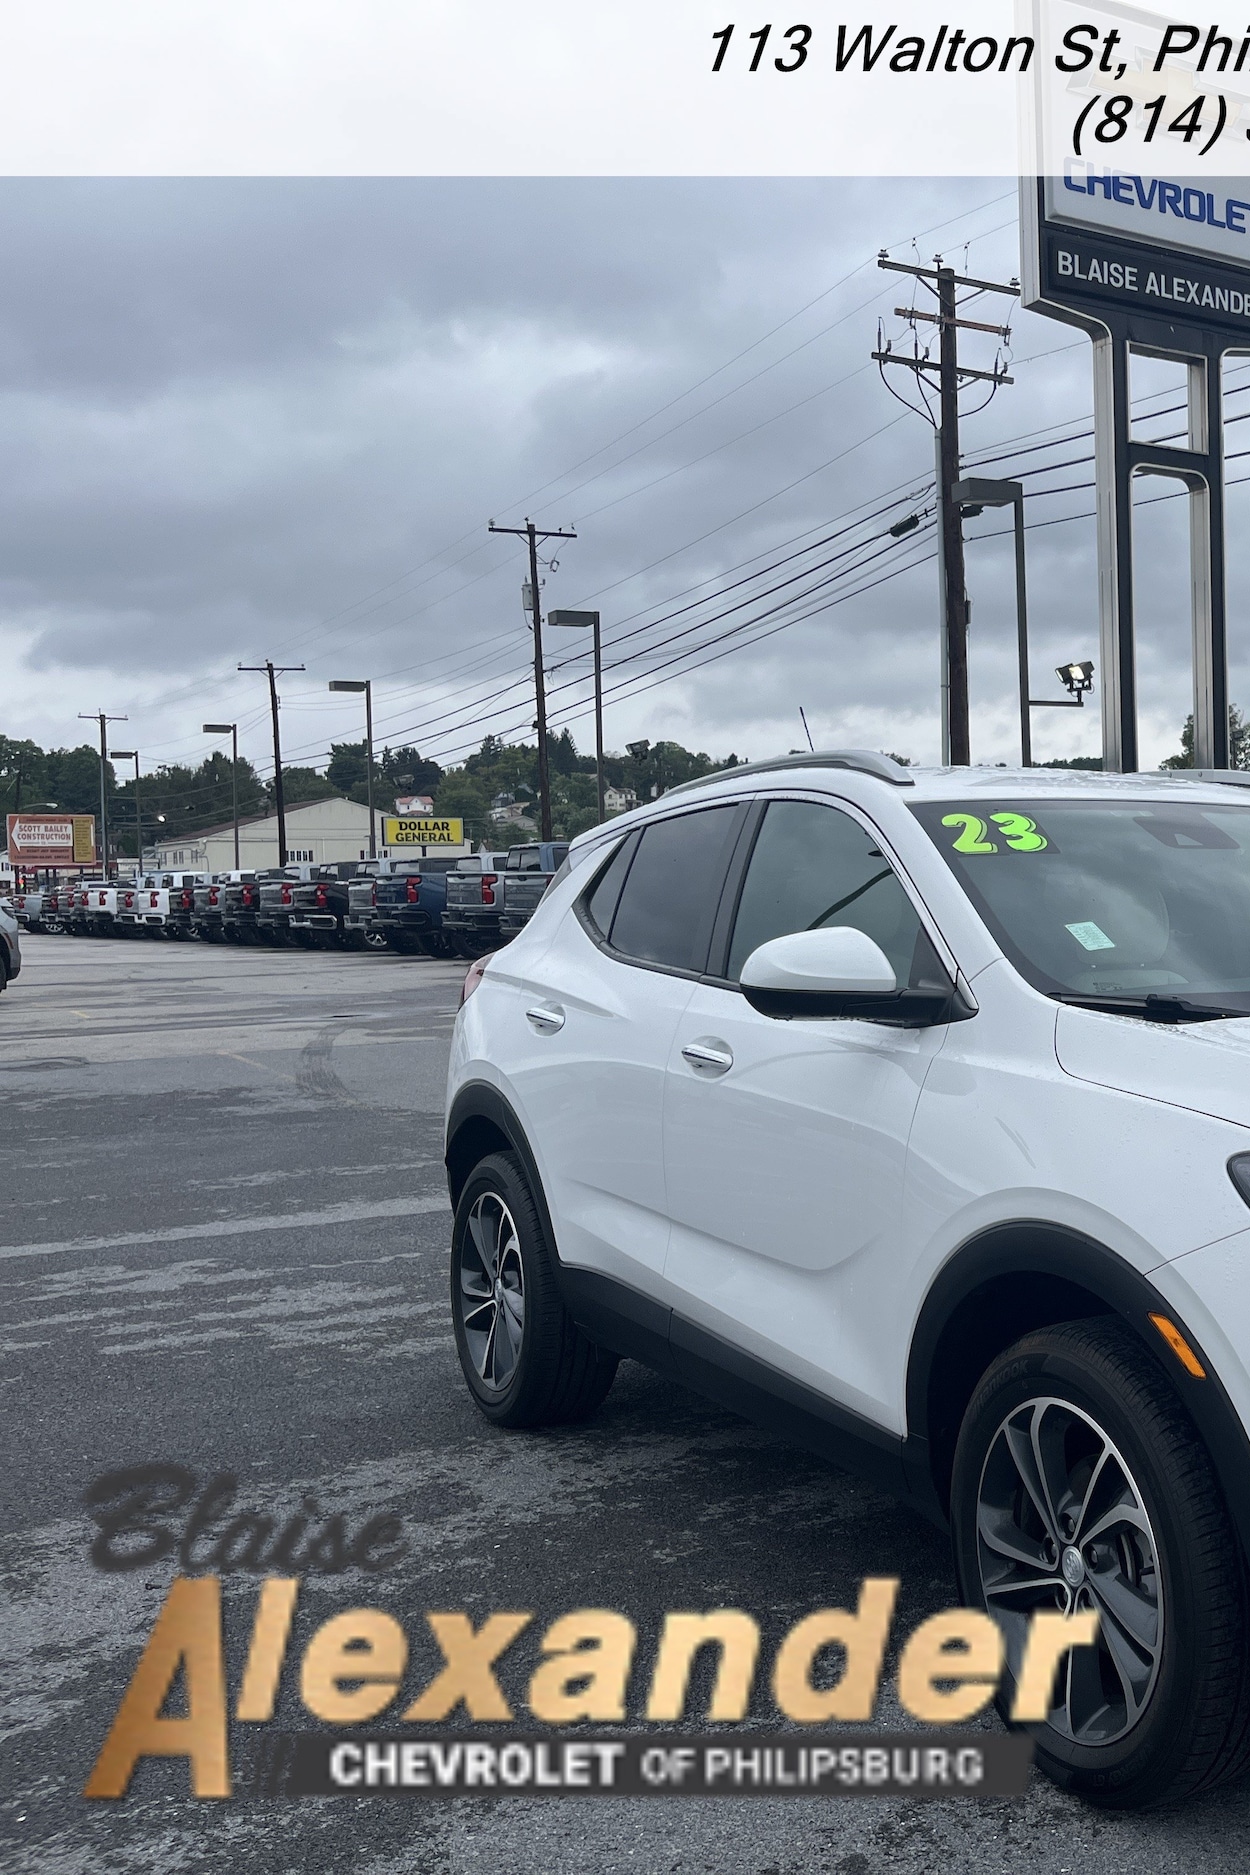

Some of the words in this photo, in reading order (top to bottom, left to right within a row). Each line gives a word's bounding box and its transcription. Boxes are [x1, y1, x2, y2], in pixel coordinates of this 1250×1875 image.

[1057, 250, 1139, 292] BLAISE
[18, 824, 41, 833] SCOTT
[44, 824, 69, 833] BAILEY
[398, 821, 450, 831] DOLLAR
[17, 833, 71, 841] CONSTRUCTION
[395, 832, 454, 842] GENERAL
[942, 812, 1048, 854] 23
